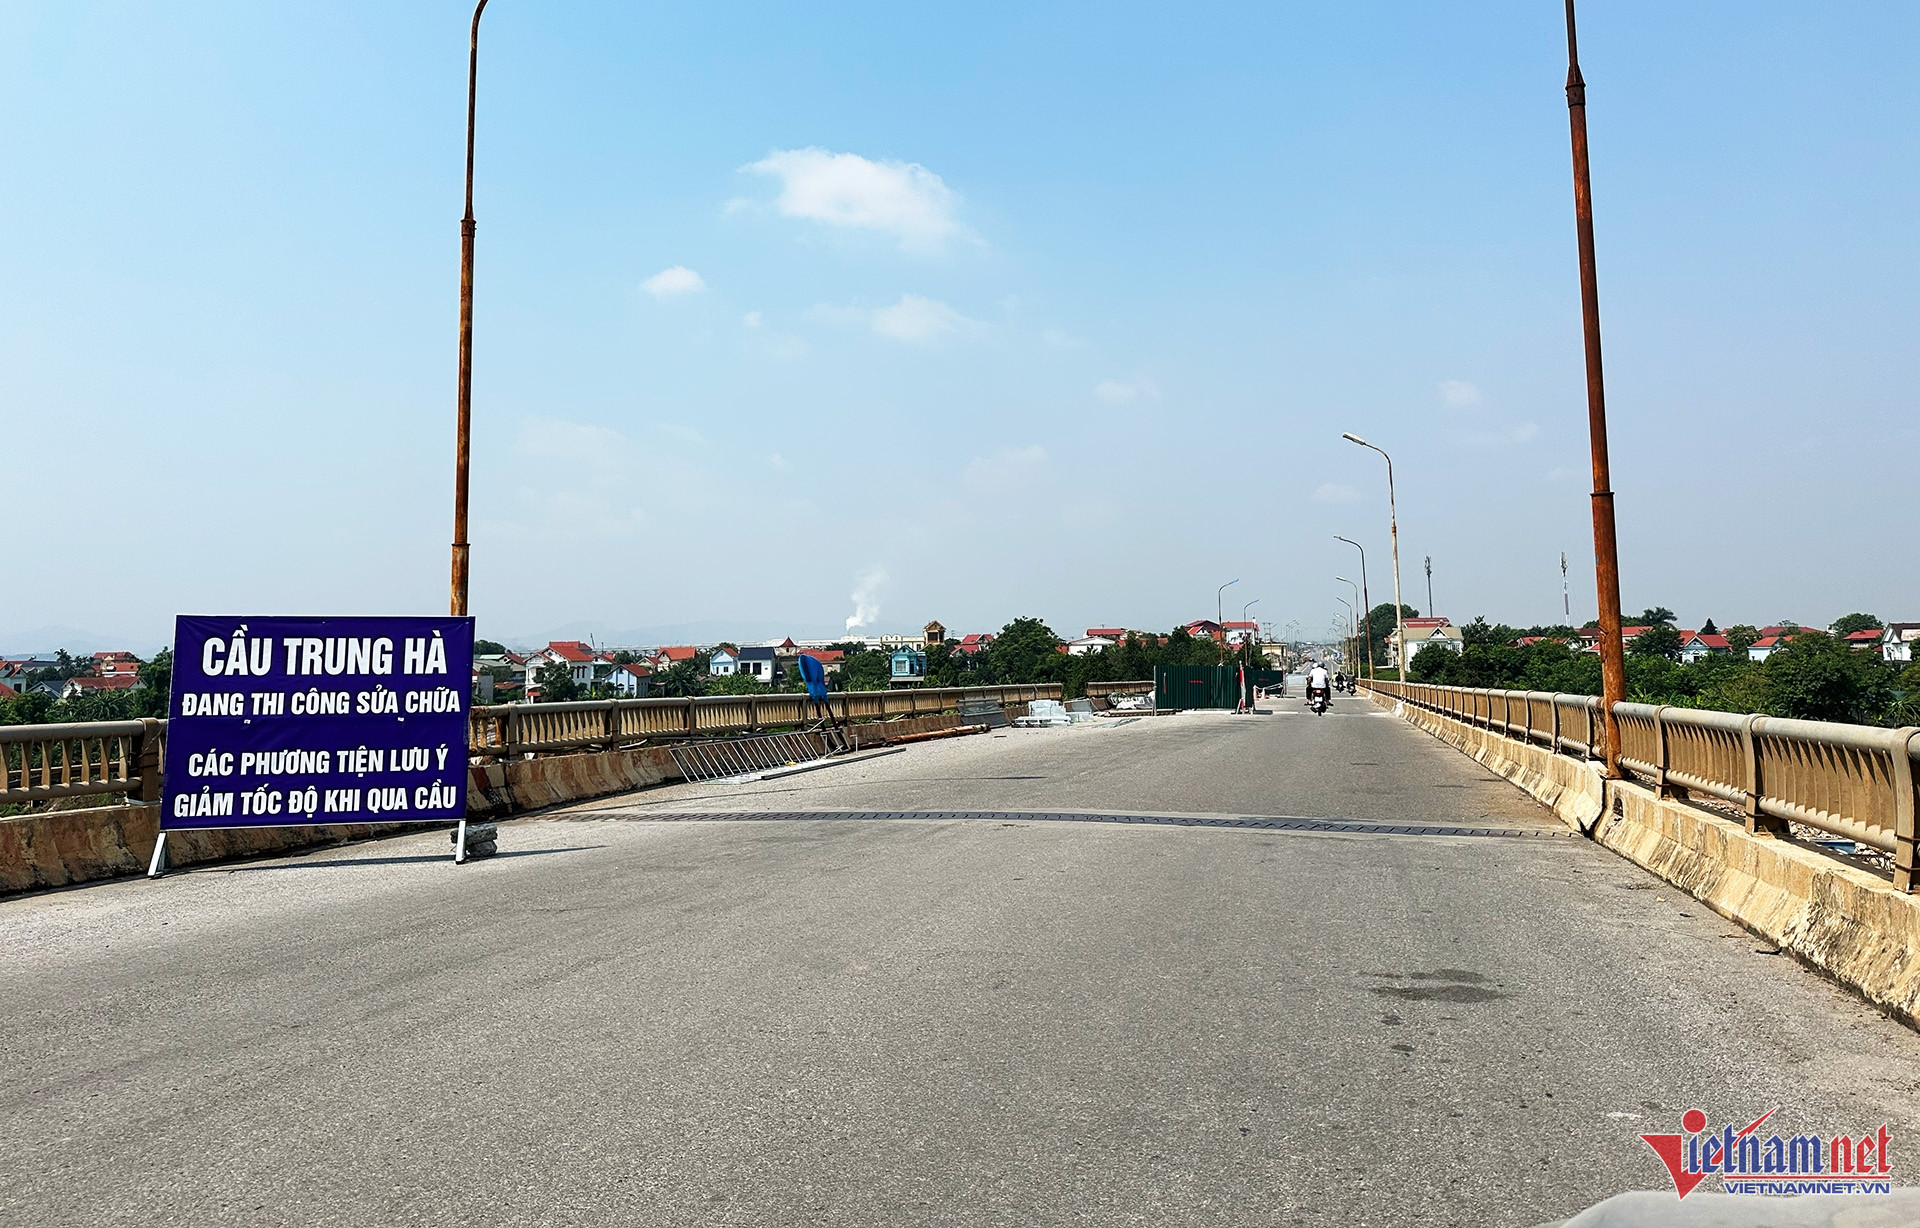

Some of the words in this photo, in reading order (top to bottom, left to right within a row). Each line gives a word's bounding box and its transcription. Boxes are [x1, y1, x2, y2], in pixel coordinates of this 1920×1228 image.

[202, 624, 273, 677] CẦU
[283, 637, 394, 676] TRUNG
[403, 629, 448, 675] HÀ
[181, 692, 245, 716] ĐANG
[250, 692, 285, 716] THI
[290, 687, 351, 715] CÔNG
[356, 683, 399, 714] SỬA
[404, 686, 461, 713] CHỮA
[188, 748, 234, 777] CÁC
[240, 748, 331, 776] PHƯƠNG
[336, 745, 384, 778] TIỆN
[389, 746, 430, 772] LƯU
[435, 743, 449, 771] Ý
[173, 785, 234, 818] GIẢM
[240, 782, 283, 815] TỐC
[287, 785, 318, 819] ĐỘ
[324, 789, 361, 813] KHI
[366, 788, 409, 814] QUA
[414, 778, 457, 810] CẦU
